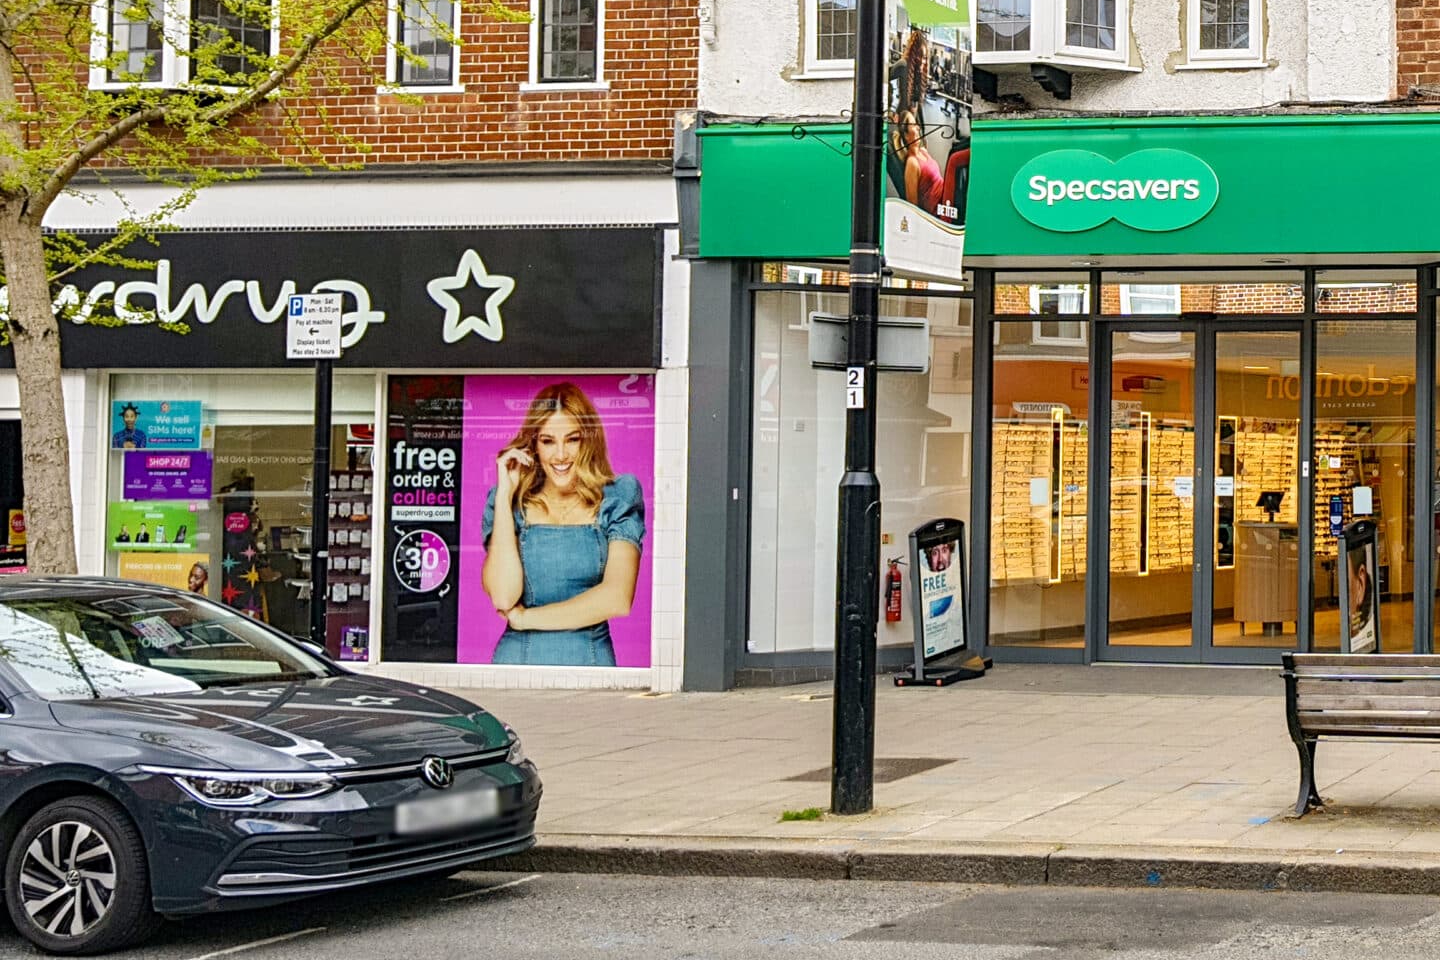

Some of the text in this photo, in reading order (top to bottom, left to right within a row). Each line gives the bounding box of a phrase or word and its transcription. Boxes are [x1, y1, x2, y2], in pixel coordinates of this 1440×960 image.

[1028, 175, 1200, 206] Specsavers
[848, 370, 859, 385] 2
[155, 415, 190, 425] We sell
[148, 425, 196, 434] SIMs here!
[149, 457, 170, 466] SHOP
[393, 440, 457, 471] free
[392, 471, 455, 488] order &
[393, 489, 455, 505] collect
[395, 510, 451, 518] superdrug.com
[404, 547, 440, 570] 30
[923, 573, 947, 592] FREE
